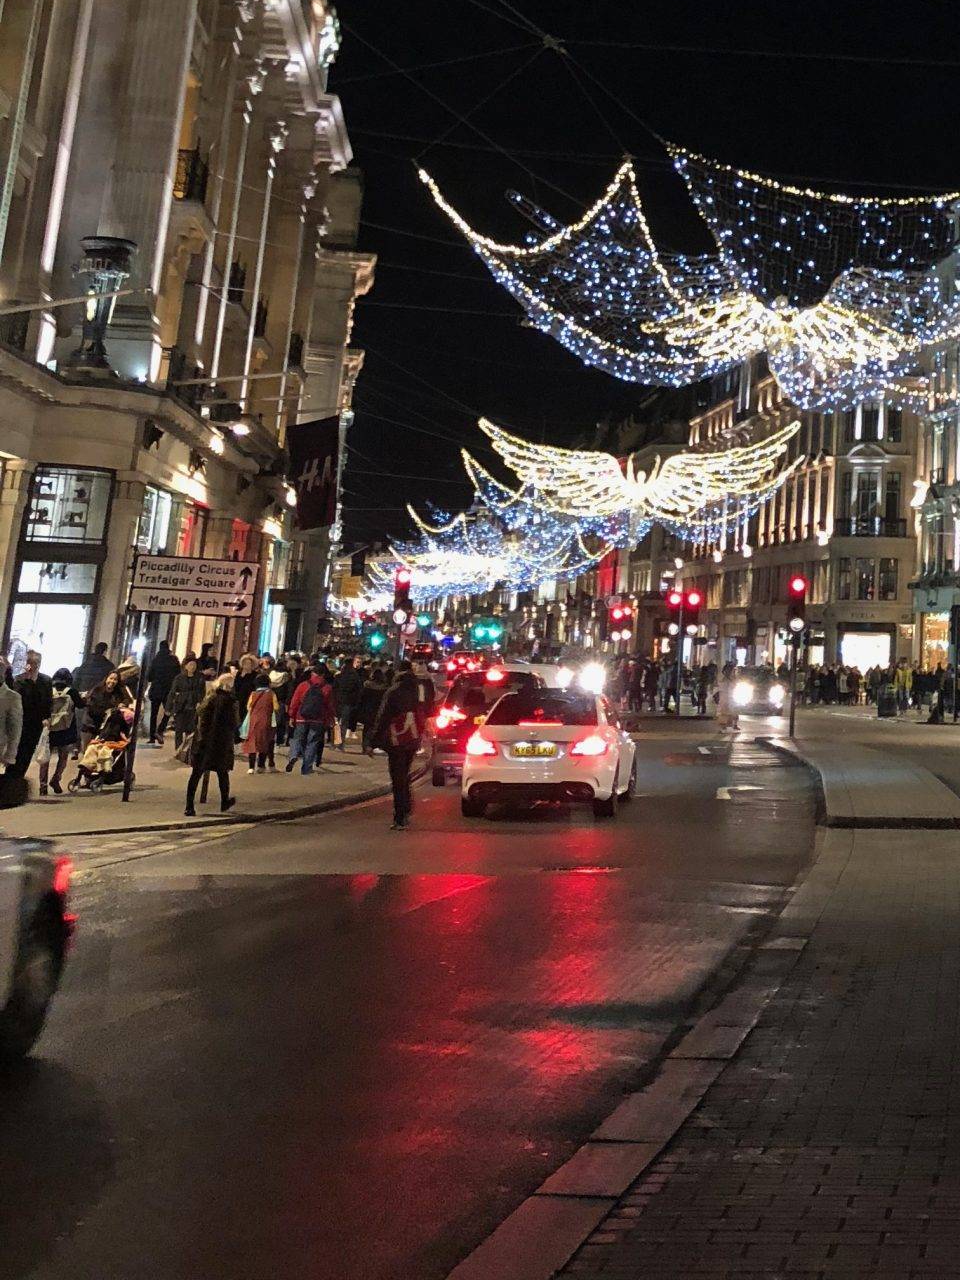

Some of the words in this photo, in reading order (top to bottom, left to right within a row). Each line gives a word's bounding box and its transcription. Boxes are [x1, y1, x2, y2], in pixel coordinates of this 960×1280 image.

[140, 560, 195, 574] Piccadilly
[199, 564, 236, 576] Circus
[139, 573, 191, 587] Trafalgar
[194, 577, 236, 588] Square
[148, 595, 188, 607] Marble
[192, 598, 219, 609] Arch
